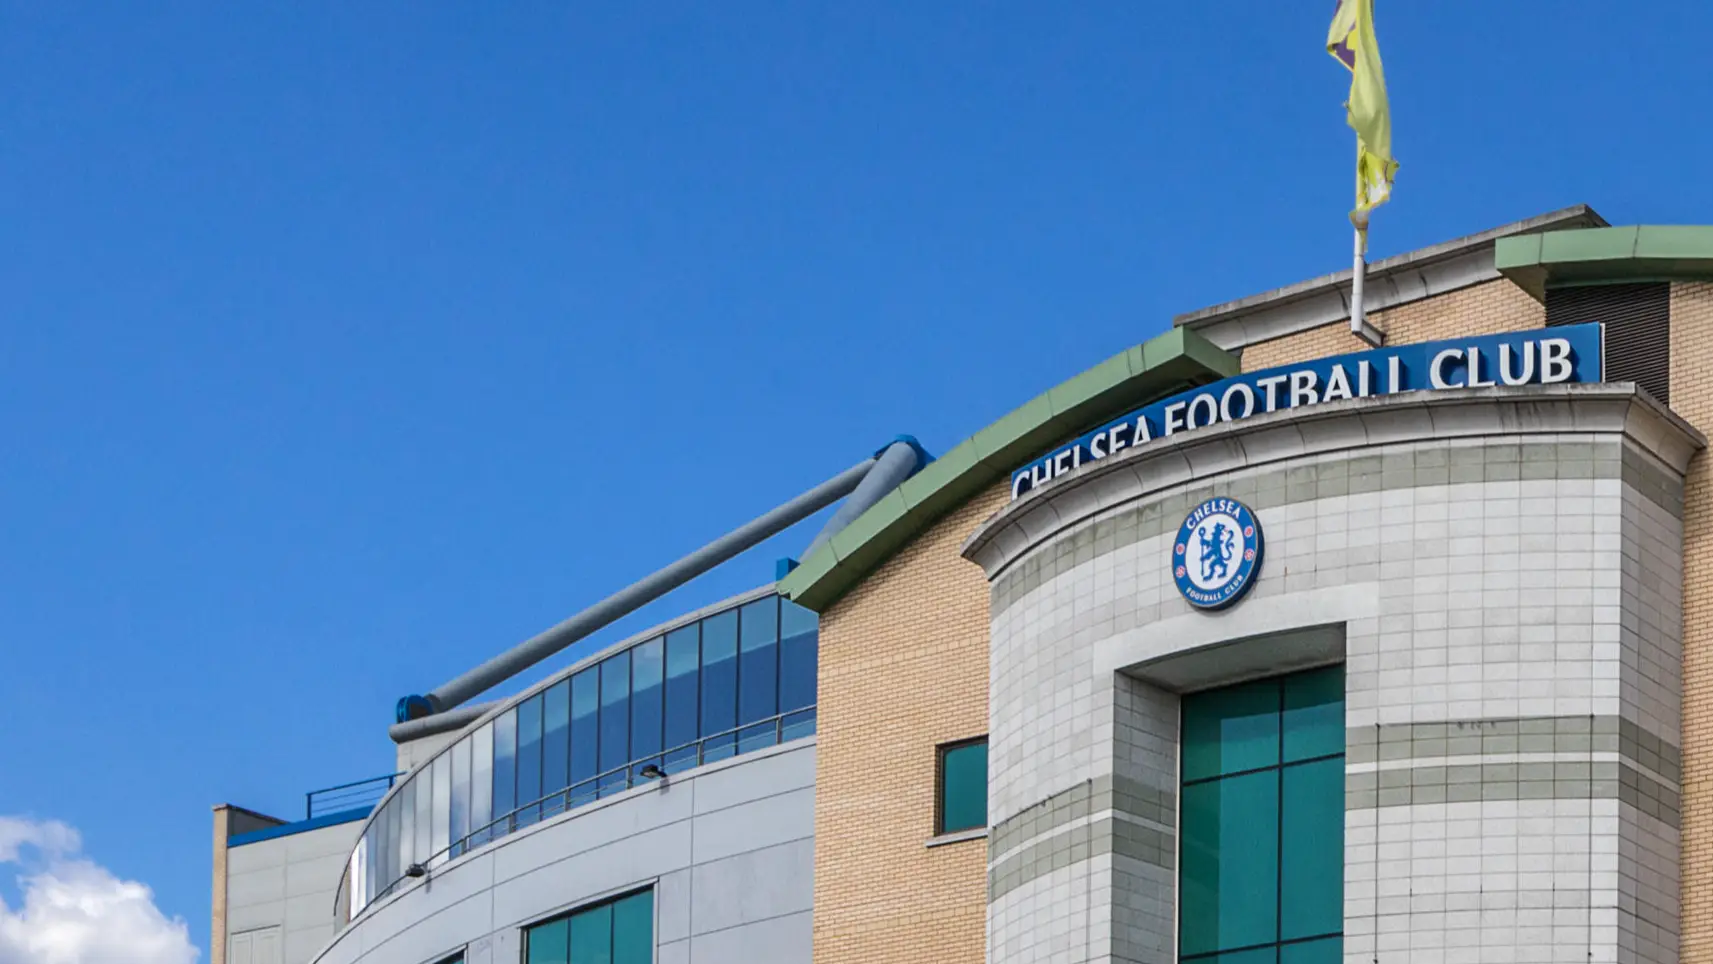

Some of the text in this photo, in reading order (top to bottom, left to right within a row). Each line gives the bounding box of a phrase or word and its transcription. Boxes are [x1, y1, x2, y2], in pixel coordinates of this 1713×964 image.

[1012, 338, 1573, 500] CHELSEA FOOTBALL CLUB
[1186, 499, 1241, 530] CHELSEA
[1186, 575, 1244, 602] FOOTBALL CLUB
